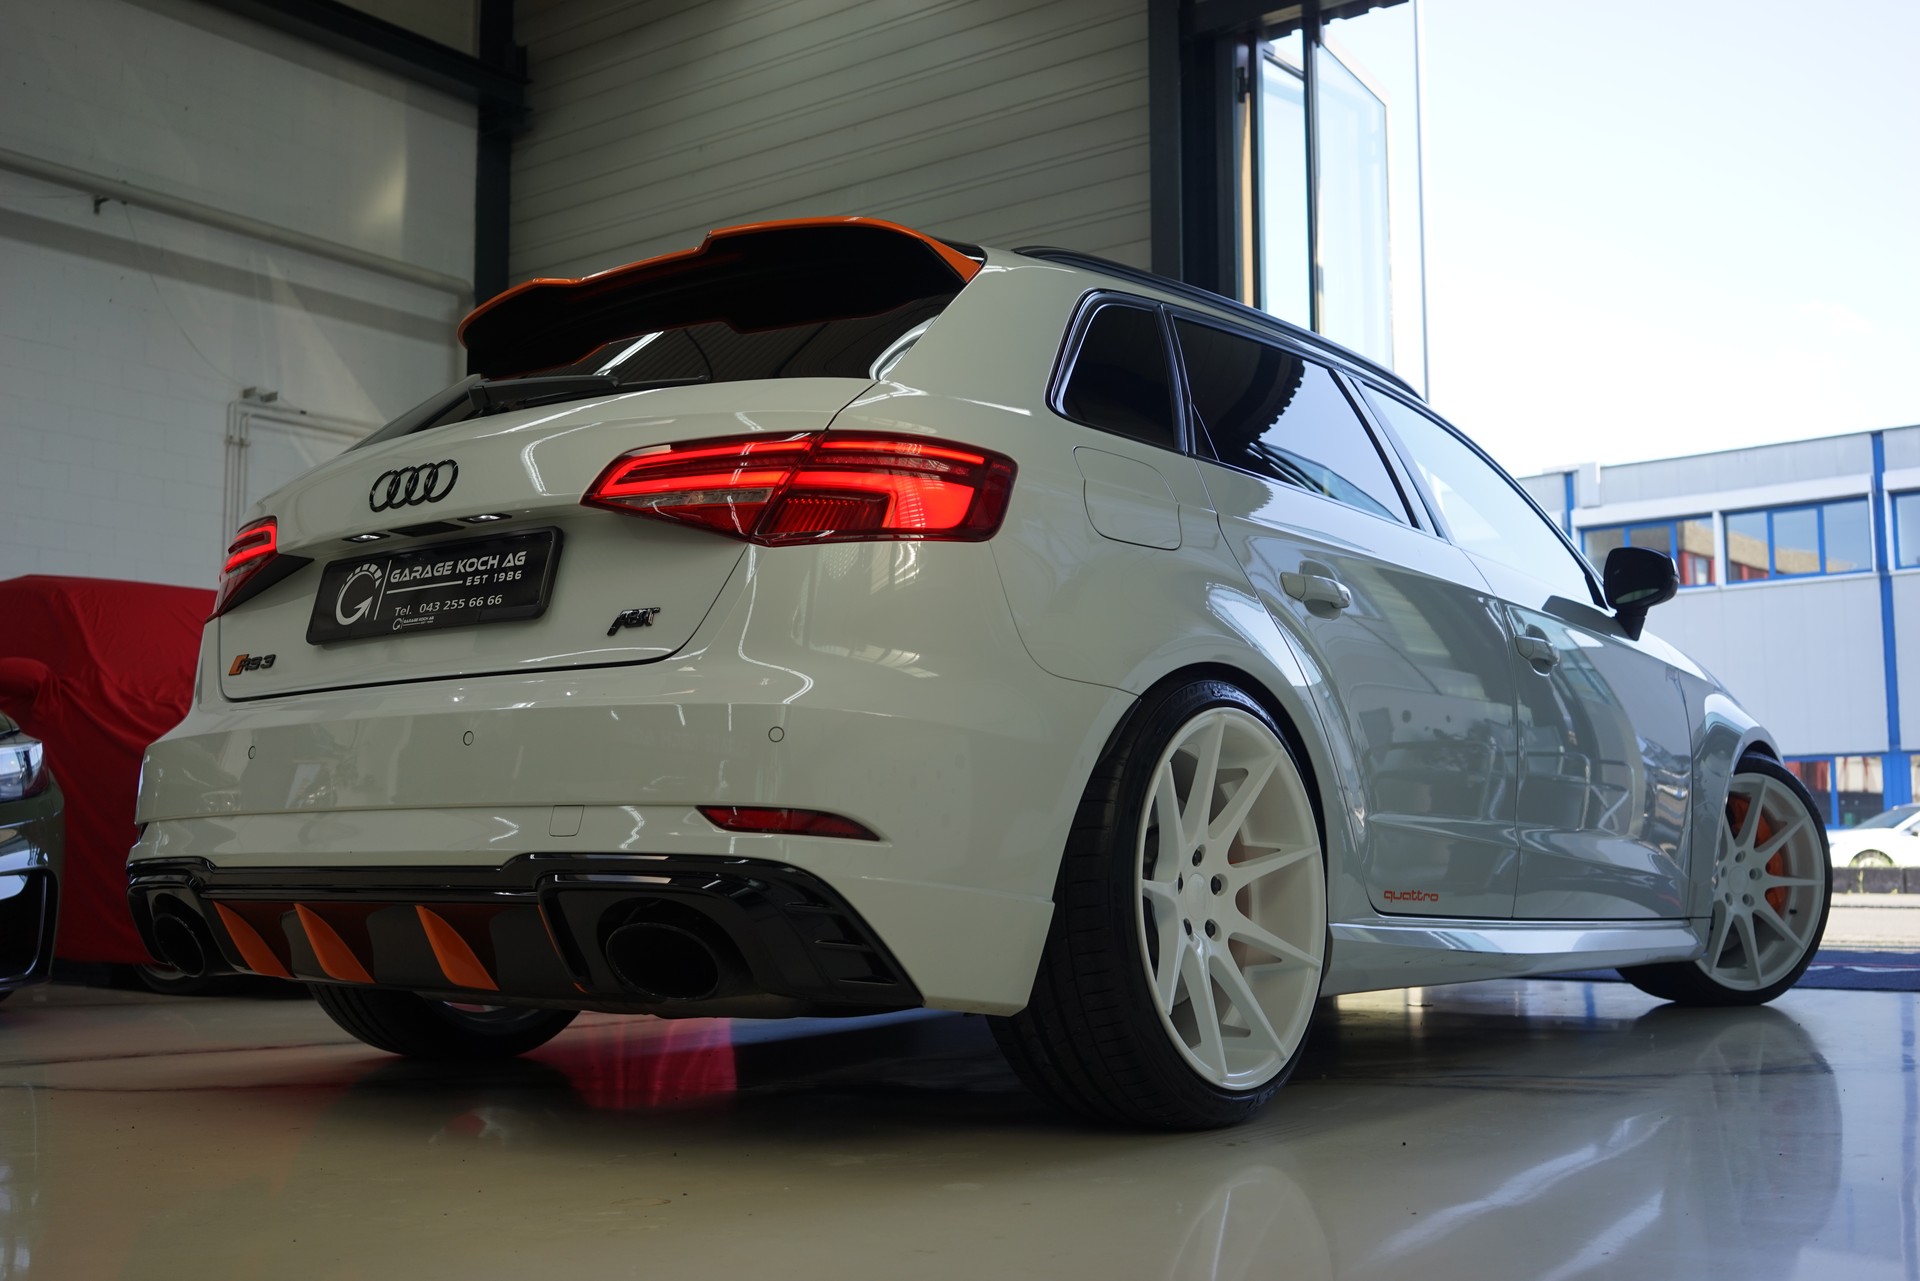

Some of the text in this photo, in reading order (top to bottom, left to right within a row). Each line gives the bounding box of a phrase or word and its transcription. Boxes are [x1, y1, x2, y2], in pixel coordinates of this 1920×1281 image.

[390, 551, 527, 583] GARAGE KOCH AG
[466, 570, 522, 586] EST 1986
[395, 594, 502, 616] Tel. 043 255 66 66
[1383, 889, 1439, 903] quattro
